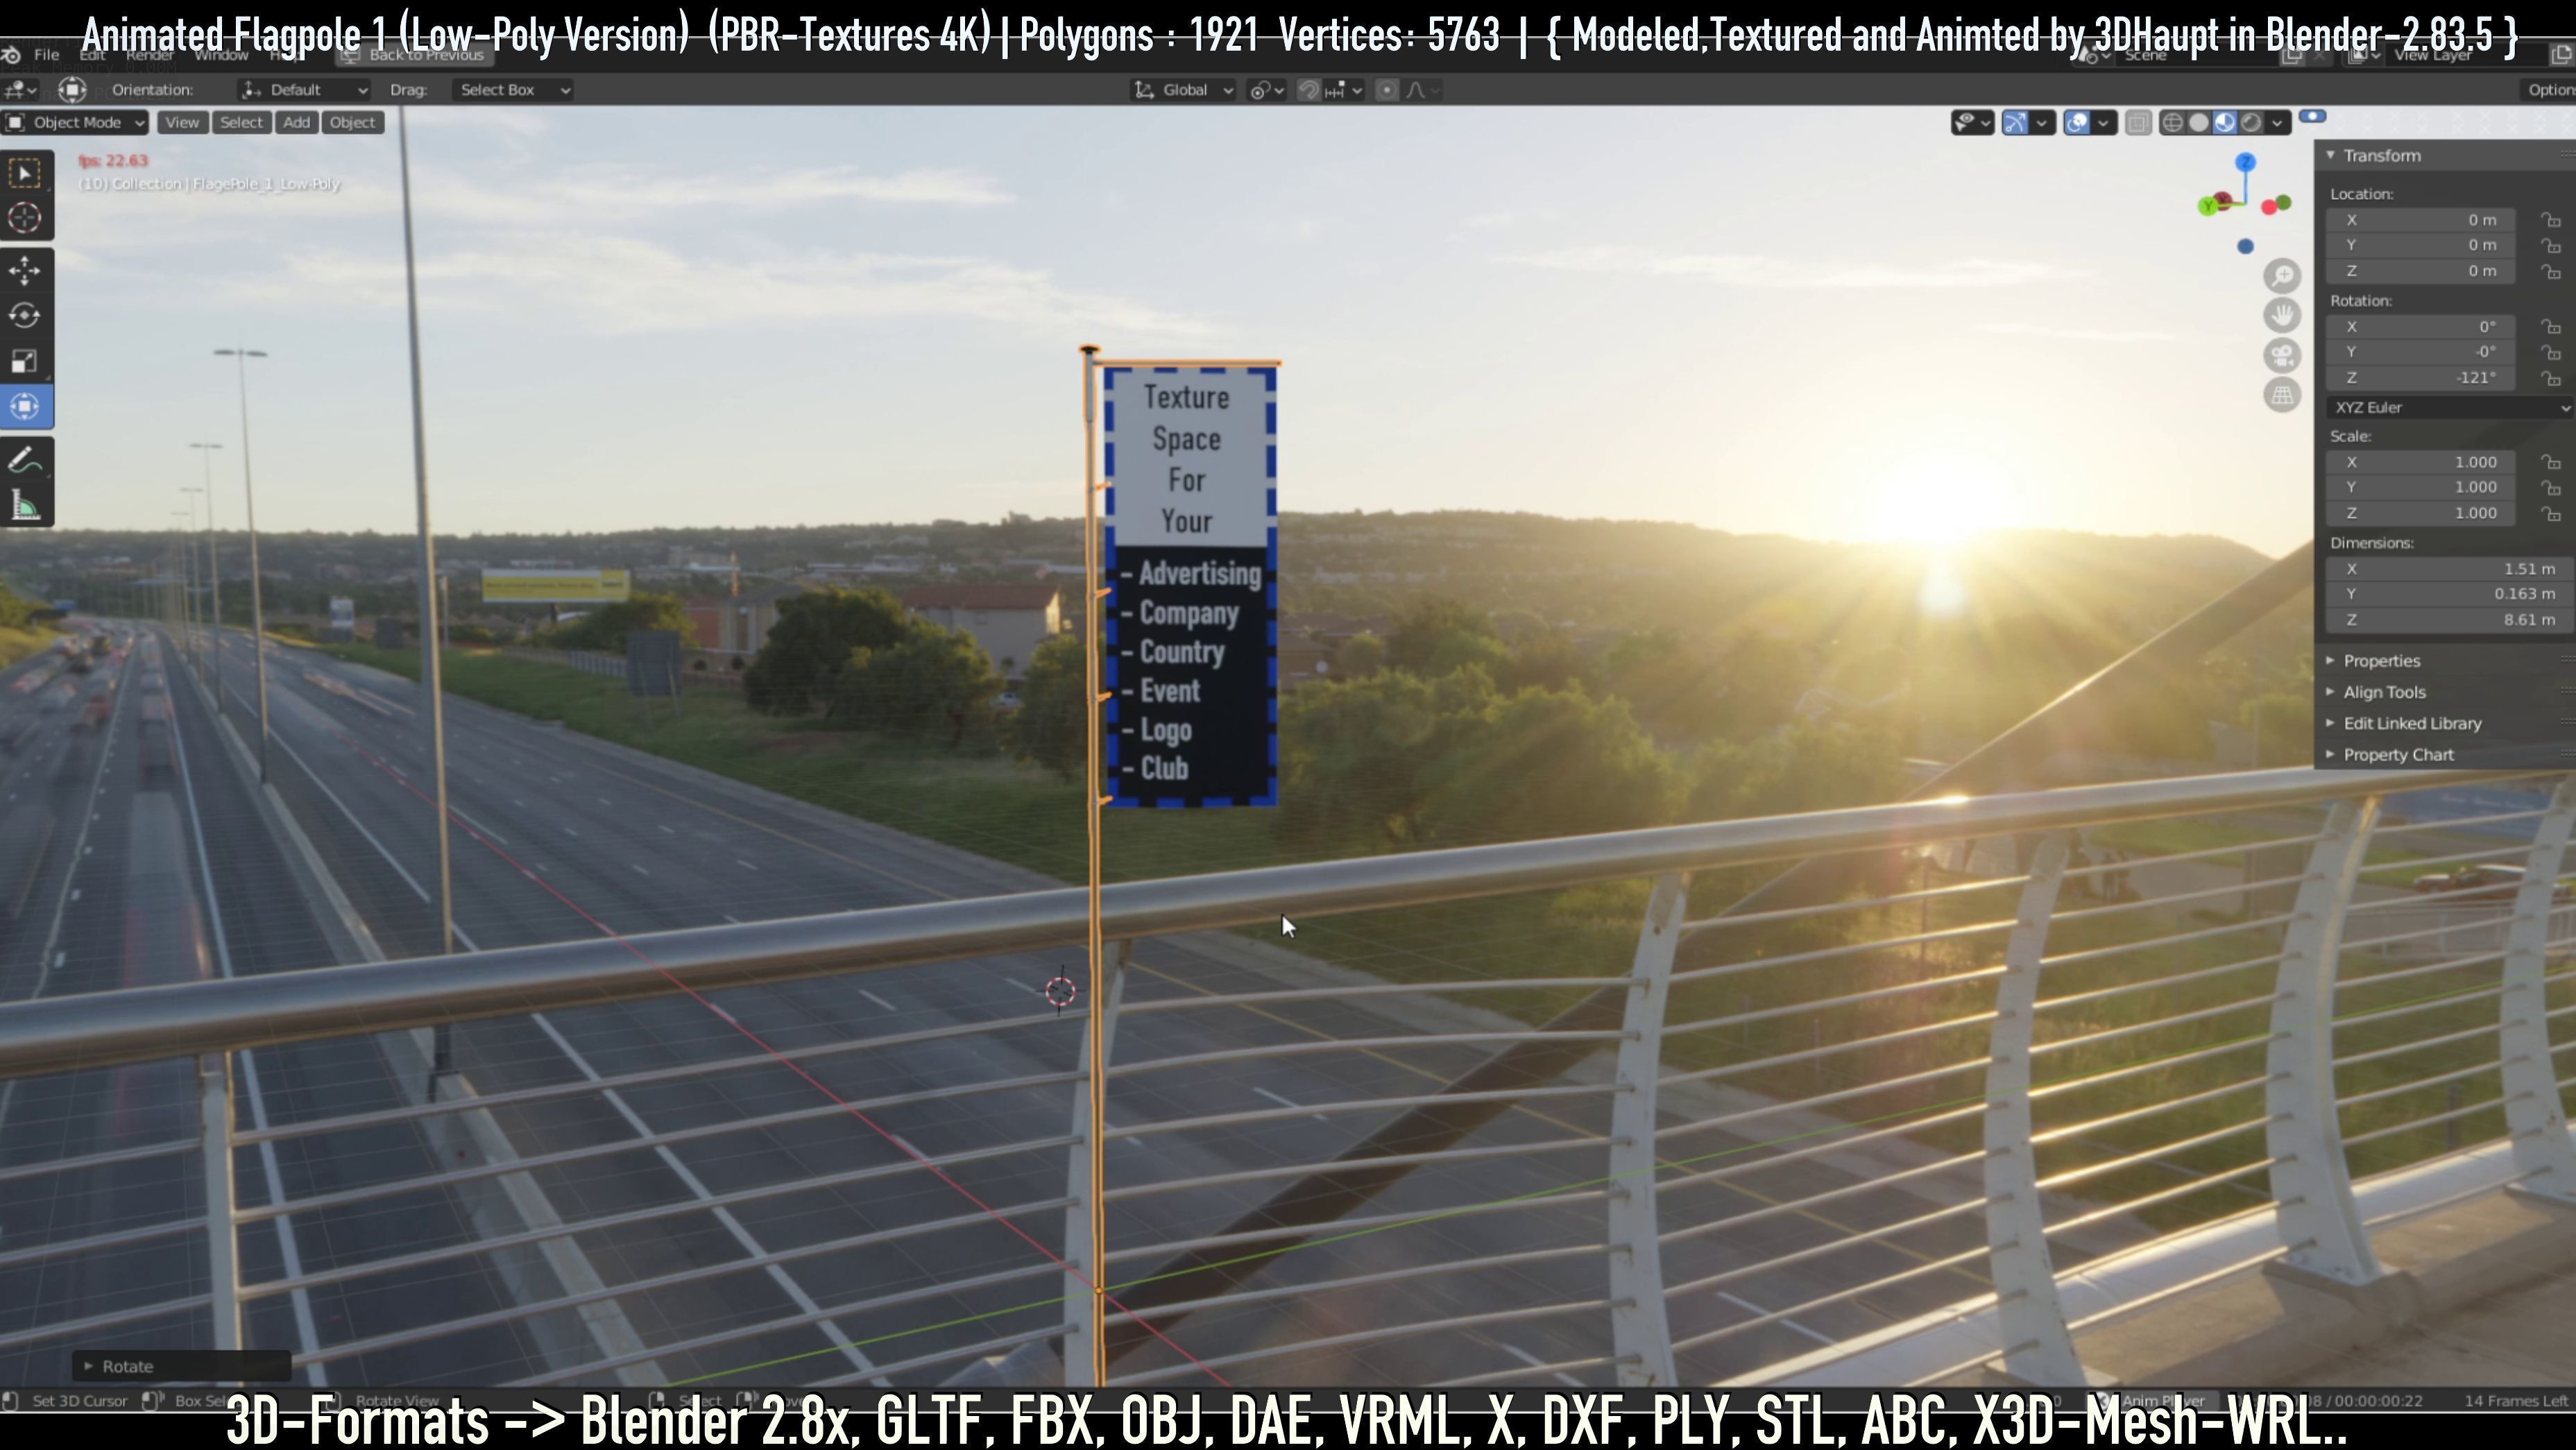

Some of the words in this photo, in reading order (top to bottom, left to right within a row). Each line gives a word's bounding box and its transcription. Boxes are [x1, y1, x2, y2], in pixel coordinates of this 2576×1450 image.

[35, 49, 59, 61] File
[80, 49, 105, 61] Edit
[127, 50, 175, 61] Render
[195, 49, 249, 61] Window
[370, 49, 404, 61] Back
[408, 49, 422, 61] to
[426, 49, 484, 61] Previous
[2125, 49, 2167, 61] Scene
[2394, 49, 2428, 62] View
[2434, 49, 2472, 65] Layer
[112, 83, 194, 96] Orientation:
[271, 83, 321, 96] Default
[391, 83, 428, 99] Drag:
[461, 83, 504, 96] Select
[509, 83, 535, 96] Box
[1163, 83, 1208, 97] Global
[34, 116, 80, 131] Object
[84, 116, 121, 130] Mode
[165, 116, 201, 130] View
[220, 116, 264, 130] Select
[283, 116, 311, 130] Add
[330, 116, 376, 131] Object
[78, 154, 101, 169] fps:
[105, 155, 148, 168] 22.63
[2344, 148, 2422, 163] Transform
[78, 177, 108, 192] (10)
[112, 177, 182, 191] Collection
[2331, 187, 2394, 201] Location:
[2347, 214, 2357, 226] X
[2468, 214, 2478, 226] 0
[2483, 217, 2497, 226] m
[2347, 239, 2357, 251] Y
[2468, 239, 2478, 251] 0
[2483, 242, 2497, 251] m
[2347, 265, 2357, 277] Z
[2468, 265, 2478, 278] 0
[2483, 268, 2497, 277] m
[2331, 295, 2393, 307] Rotation:
[2347, 321, 2357, 333] X
[2480, 321, 2497, 333] 0°
[2347, 346, 2357, 358] Y
[2475, 346, 2497, 358] -0°
[2347, 372, 2357, 384] Z
[2457, 371, 2497, 384] -121°
[1145, 383, 1230, 409] Texture
[2336, 402, 2364, 414] XYZ
[2368, 401, 2403, 414] Euler
[1153, 425, 1222, 457] Space
[2331, 430, 2372, 443] Scale:
[2347, 457, 2357, 468] X
[2455, 456, 2498, 468] 1.000
[1169, 466, 1206, 492] For
[2347, 481, 2357, 493] Y
[2455, 481, 2498, 493] 1.000
[1161, 507, 1213, 534] Your
[2347, 508, 2357, 519] Z
[2455, 507, 2498, 520] 1.000
[2331, 536, 2414, 549] Dimensions:
[1139, 559, 1262, 592] Advertising
[2347, 563, 2357, 575] X
[2505, 563, 2537, 575] 1.51
[2542, 566, 2556, 575] m
[2347, 588, 2357, 599] Y
[2495, 588, 2537, 600] 0.163
[2542, 591, 2556, 599] m
[1140, 599, 1240, 631] Company
[2347, 614, 2357, 626] Z
[2505, 613, 2537, 626] 8.61
[2542, 617, 2556, 626] m
[1141, 638, 1225, 670] Country
[2344, 654, 2421, 670] Properties
[1141, 677, 1201, 703] Event
[2344, 685, 2382, 702] Align
[2387, 685, 2426, 699] Tools
[1141, 716, 1193, 748] Logo
[2345, 717, 2373, 731] Edit
[2378, 717, 2426, 731] Linked
[2431, 717, 2482, 733] Library
[2345, 748, 2408, 765] Property
[2413, 747, 2455, 761] Chart
[1141, 755, 1188, 781] Club
[103, 1360, 154, 1374] Rotate
[33, 1394, 55, 1408] Set
[59, 1395, 80, 1408] 3D
[83, 1395, 129, 1408] Cursor
[176, 1394, 201, 1407] Box
[356, 1394, 402, 1407] Rotate
[405, 1394, 440, 1407] View
[2122, 1394, 2158, 1407] Anim
[2335, 1394, 2423, 1408] 00:00:00:22
[2466, 1394, 2484, 1408] 14
[2489, 1394, 2539, 1408] Frames
[2543, 1394, 2570, 1408] Left
